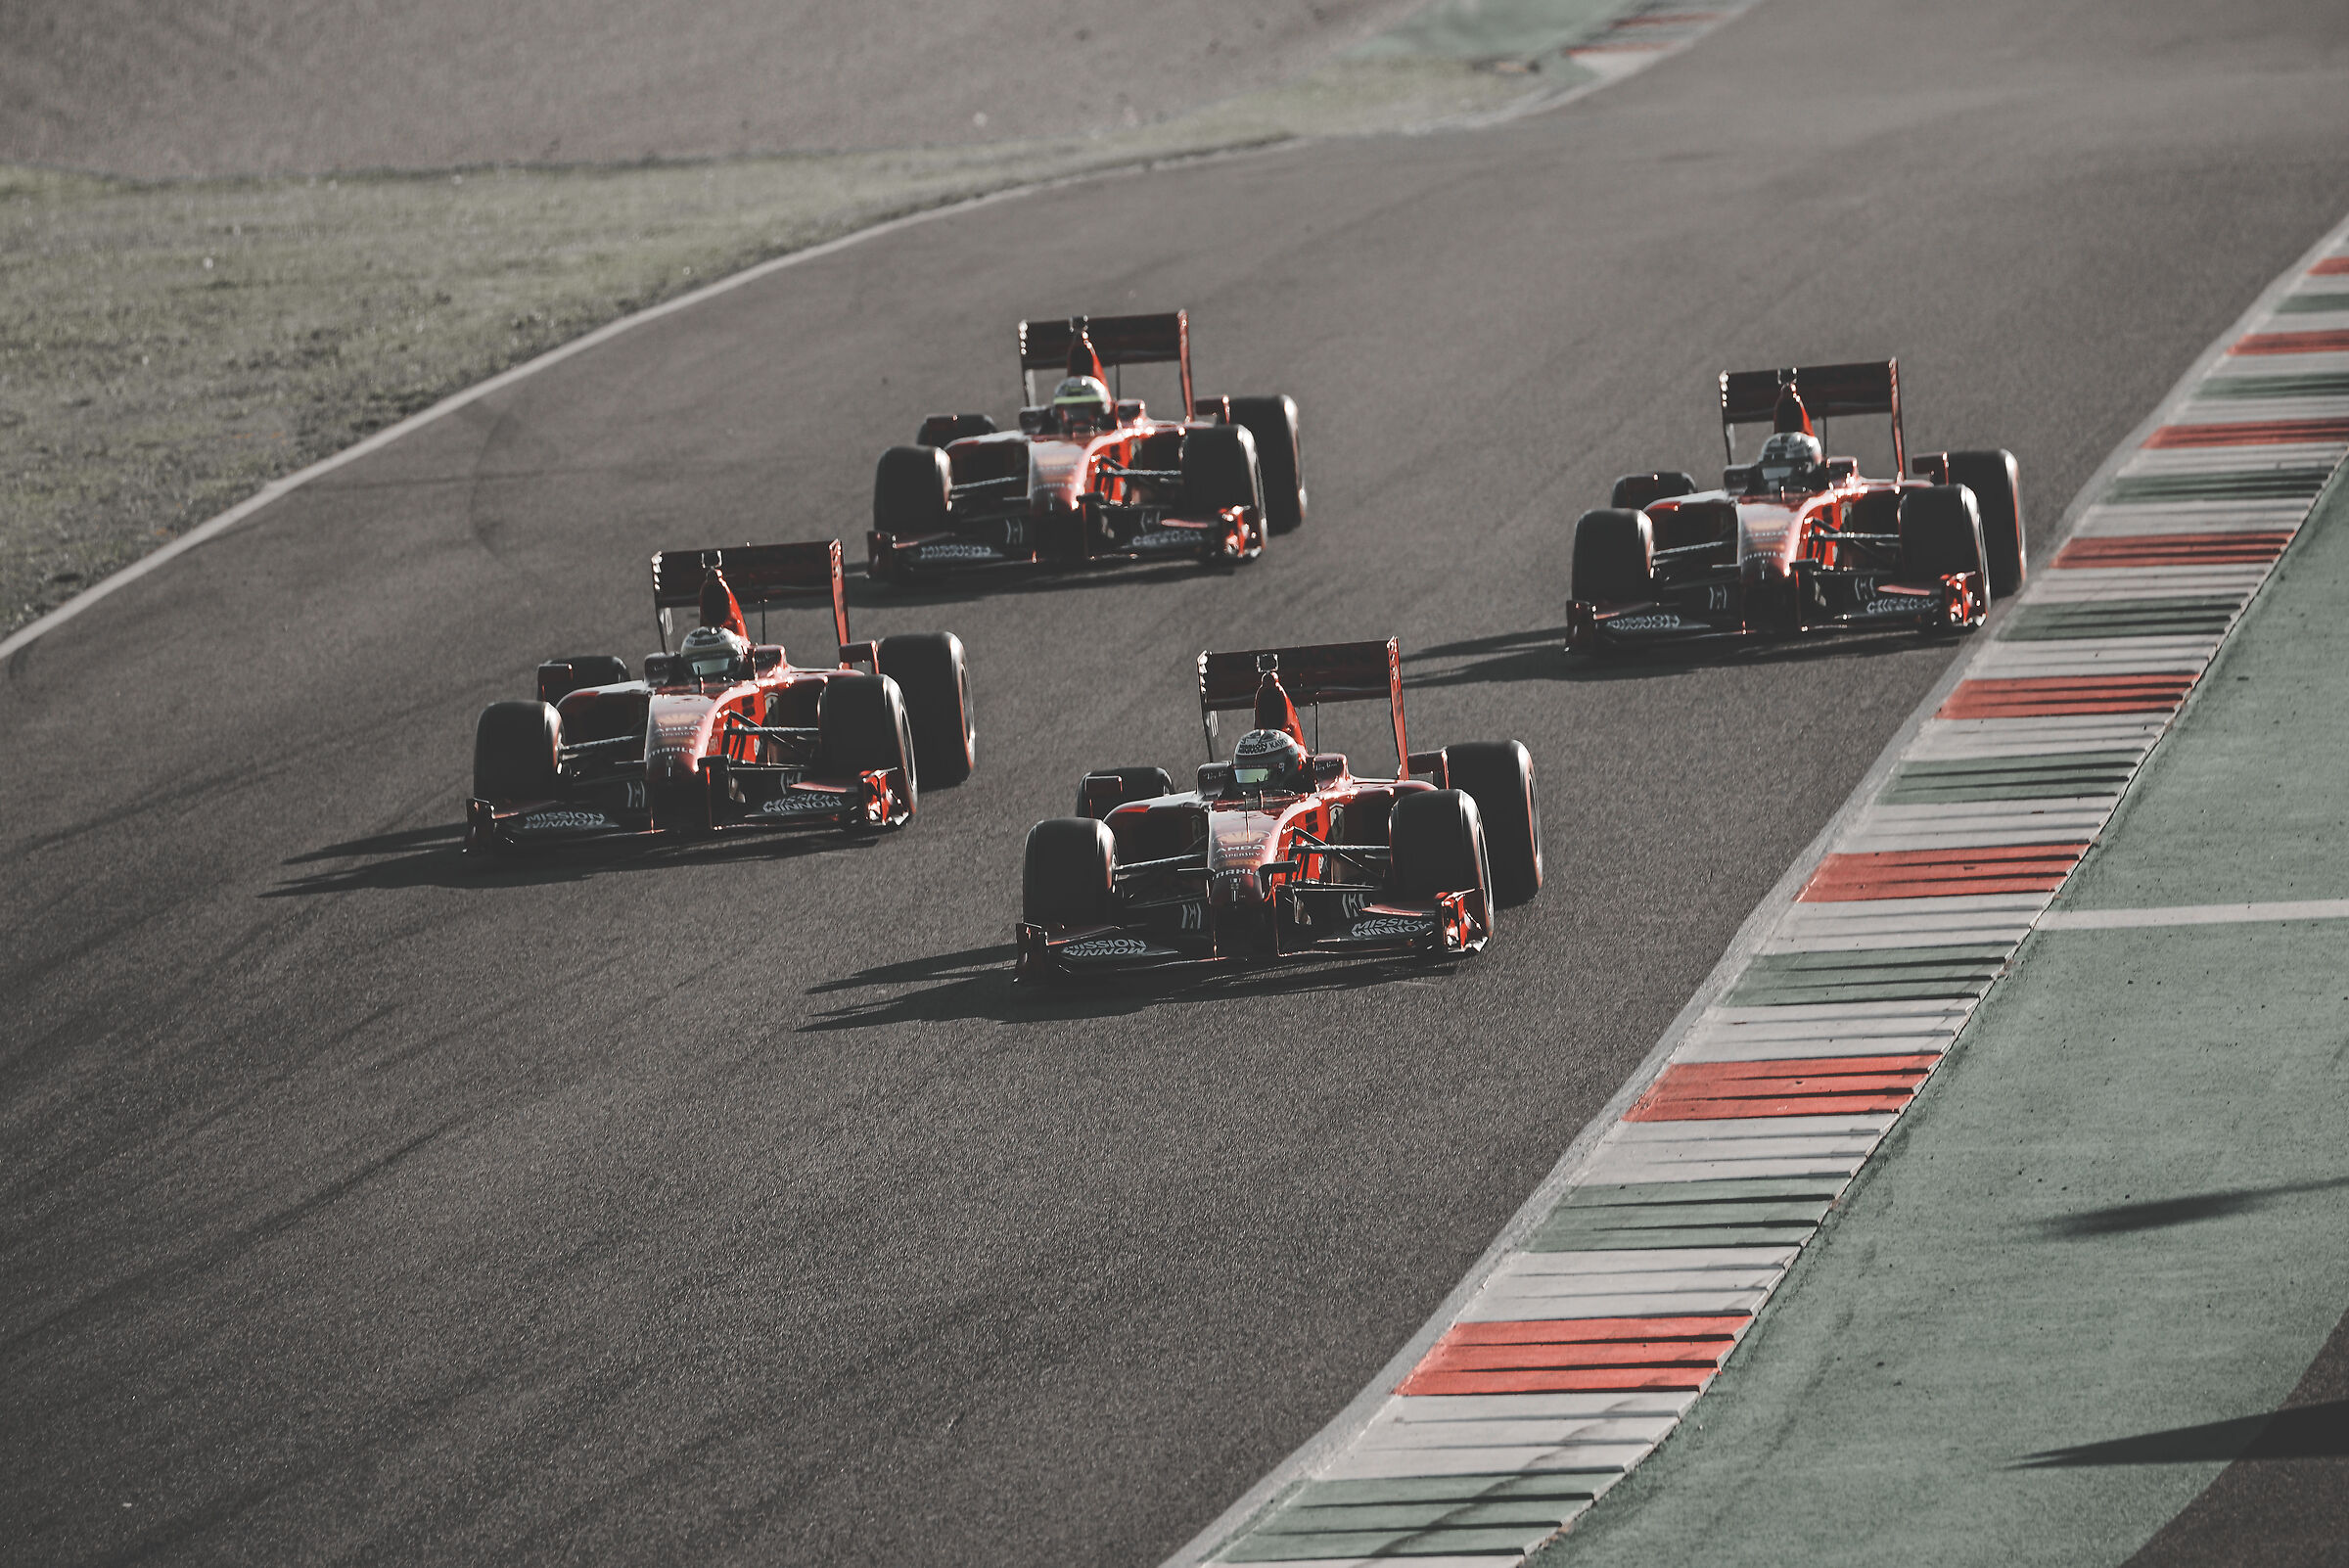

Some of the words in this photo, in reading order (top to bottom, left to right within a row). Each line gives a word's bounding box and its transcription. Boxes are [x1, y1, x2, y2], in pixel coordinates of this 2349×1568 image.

[526, 811, 605, 823] MISSION
[1353, 918, 1427, 931] MISSIO
[1064, 939, 1147, 951] MISSION
